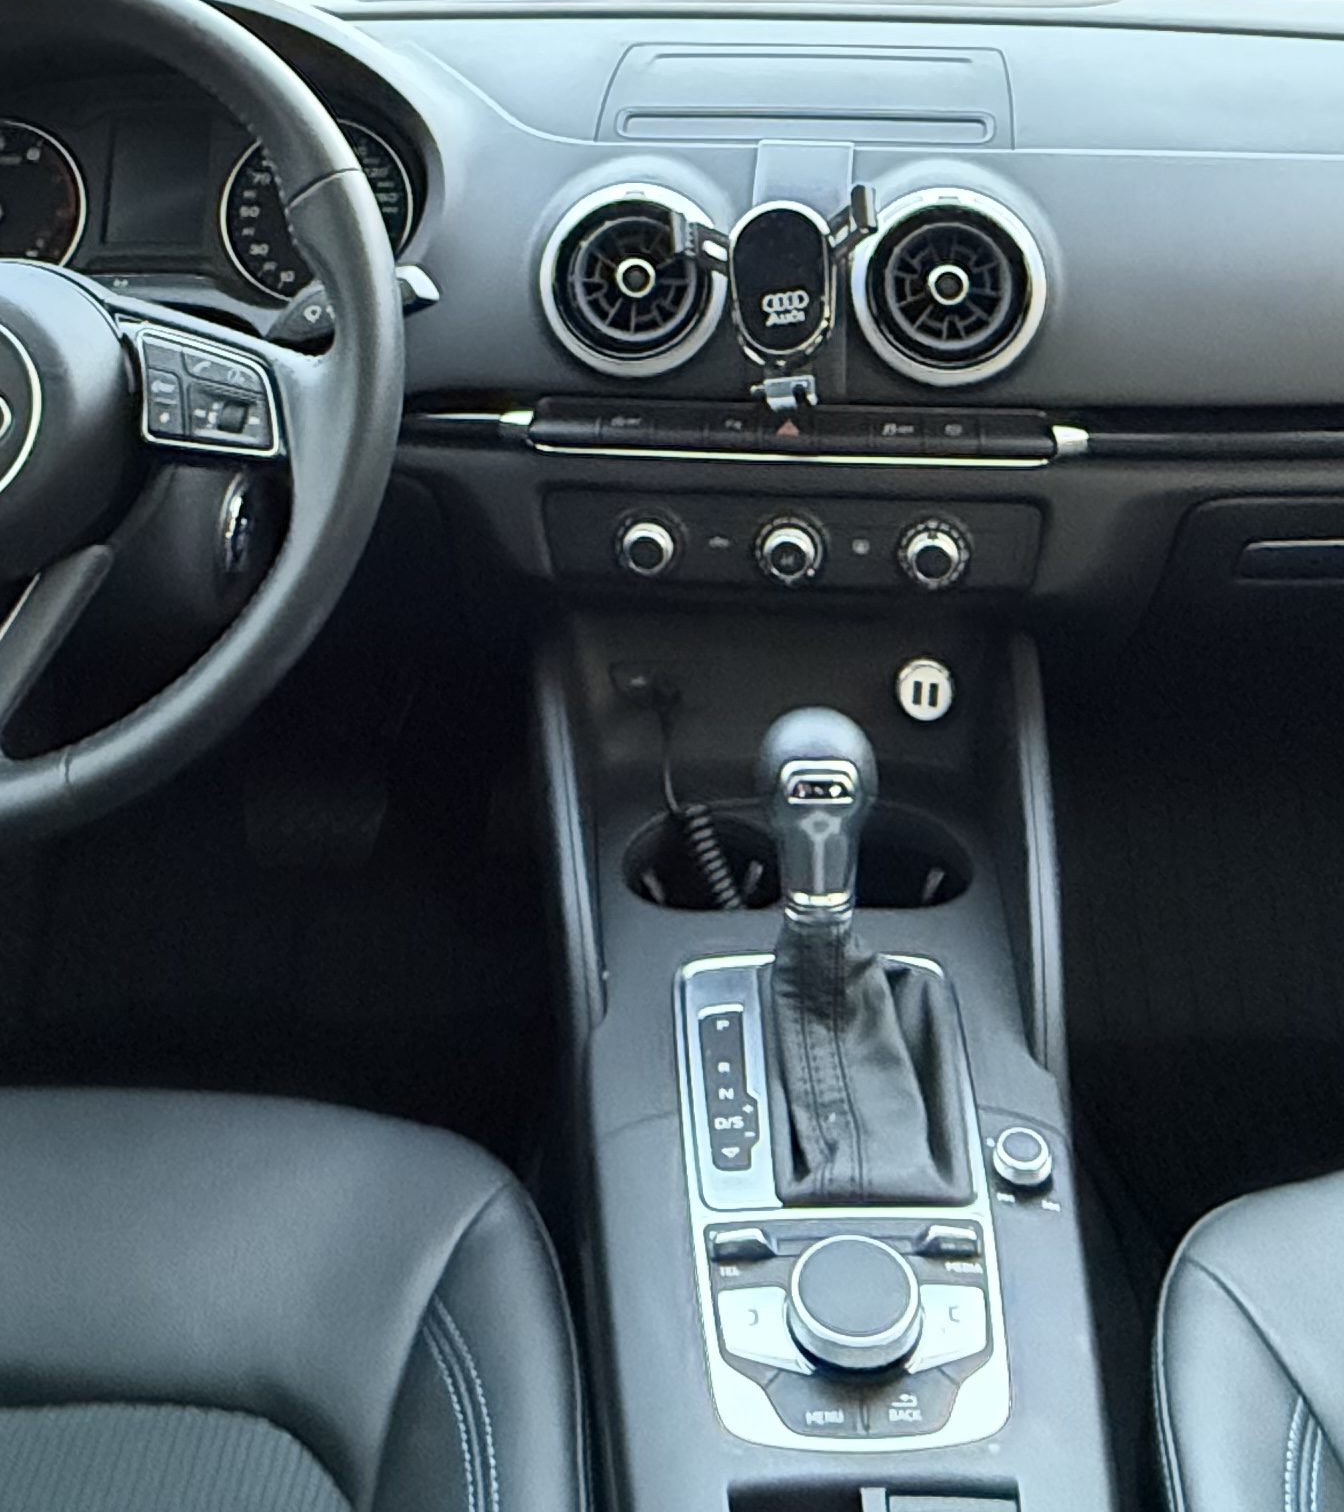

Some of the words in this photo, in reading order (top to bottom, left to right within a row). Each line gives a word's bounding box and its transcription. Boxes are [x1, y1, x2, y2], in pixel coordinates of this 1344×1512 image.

[765, 309, 806, 327] Audi
[716, 1019, 730, 1031] P
[718, 1087, 735, 1100] N
[714, 1115, 744, 1130] D/S
[805, 1408, 845, 1426] MENU
[888, 1407, 923, 1422] BACK
